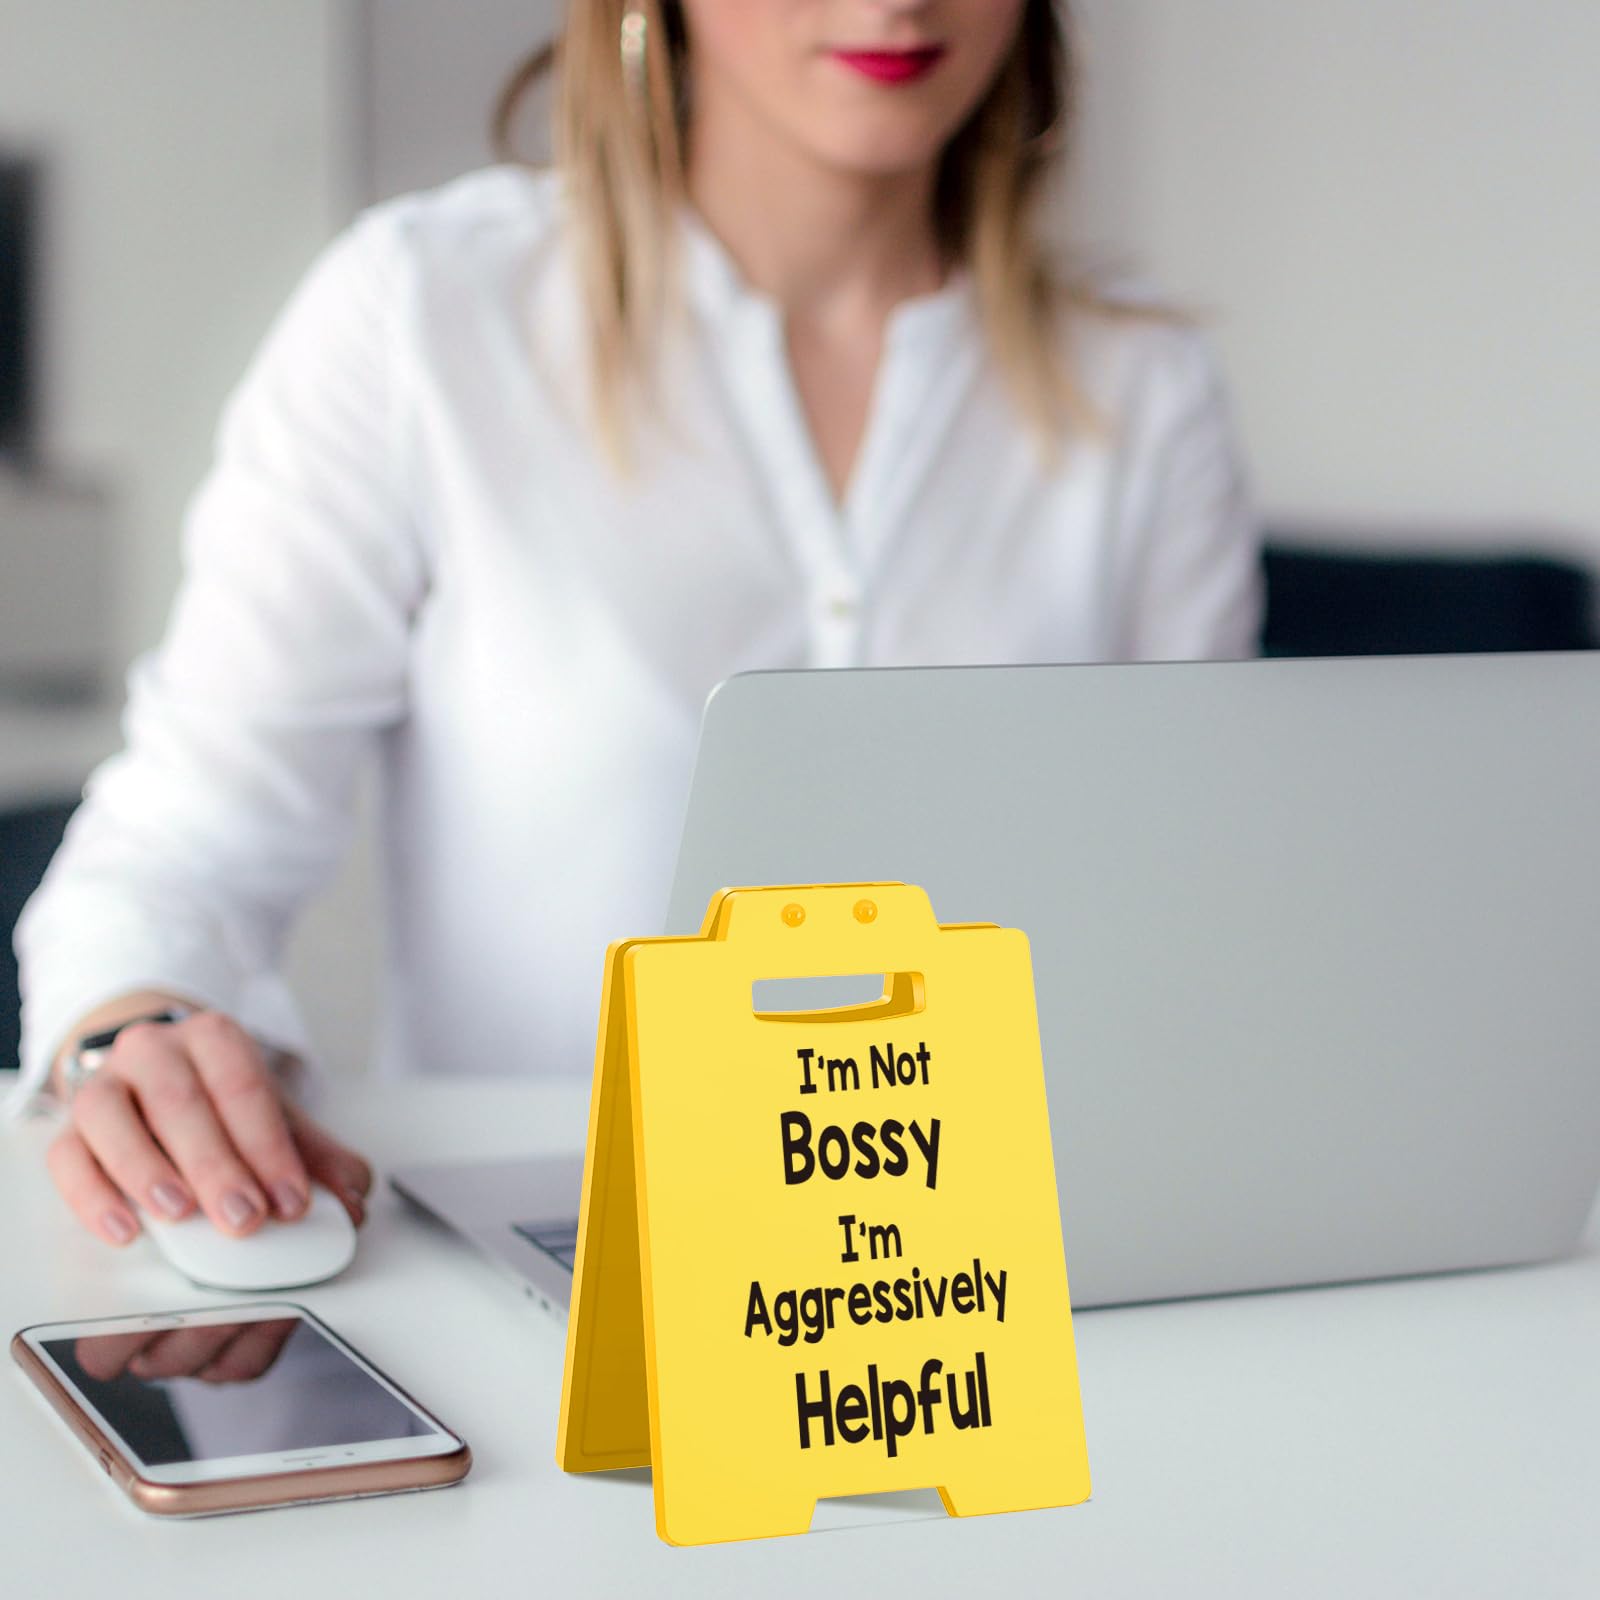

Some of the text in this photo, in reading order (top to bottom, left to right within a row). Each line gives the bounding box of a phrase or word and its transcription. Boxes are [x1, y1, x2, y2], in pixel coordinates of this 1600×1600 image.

[796, 1041, 931, 1095] I'm Not
[780, 1110, 941, 1190] Bossy
[838, 1214, 903, 1263] I'm
[744, 1258, 1007, 1347] Aggressively
[795, 1351, 992, 1458] Helpful
